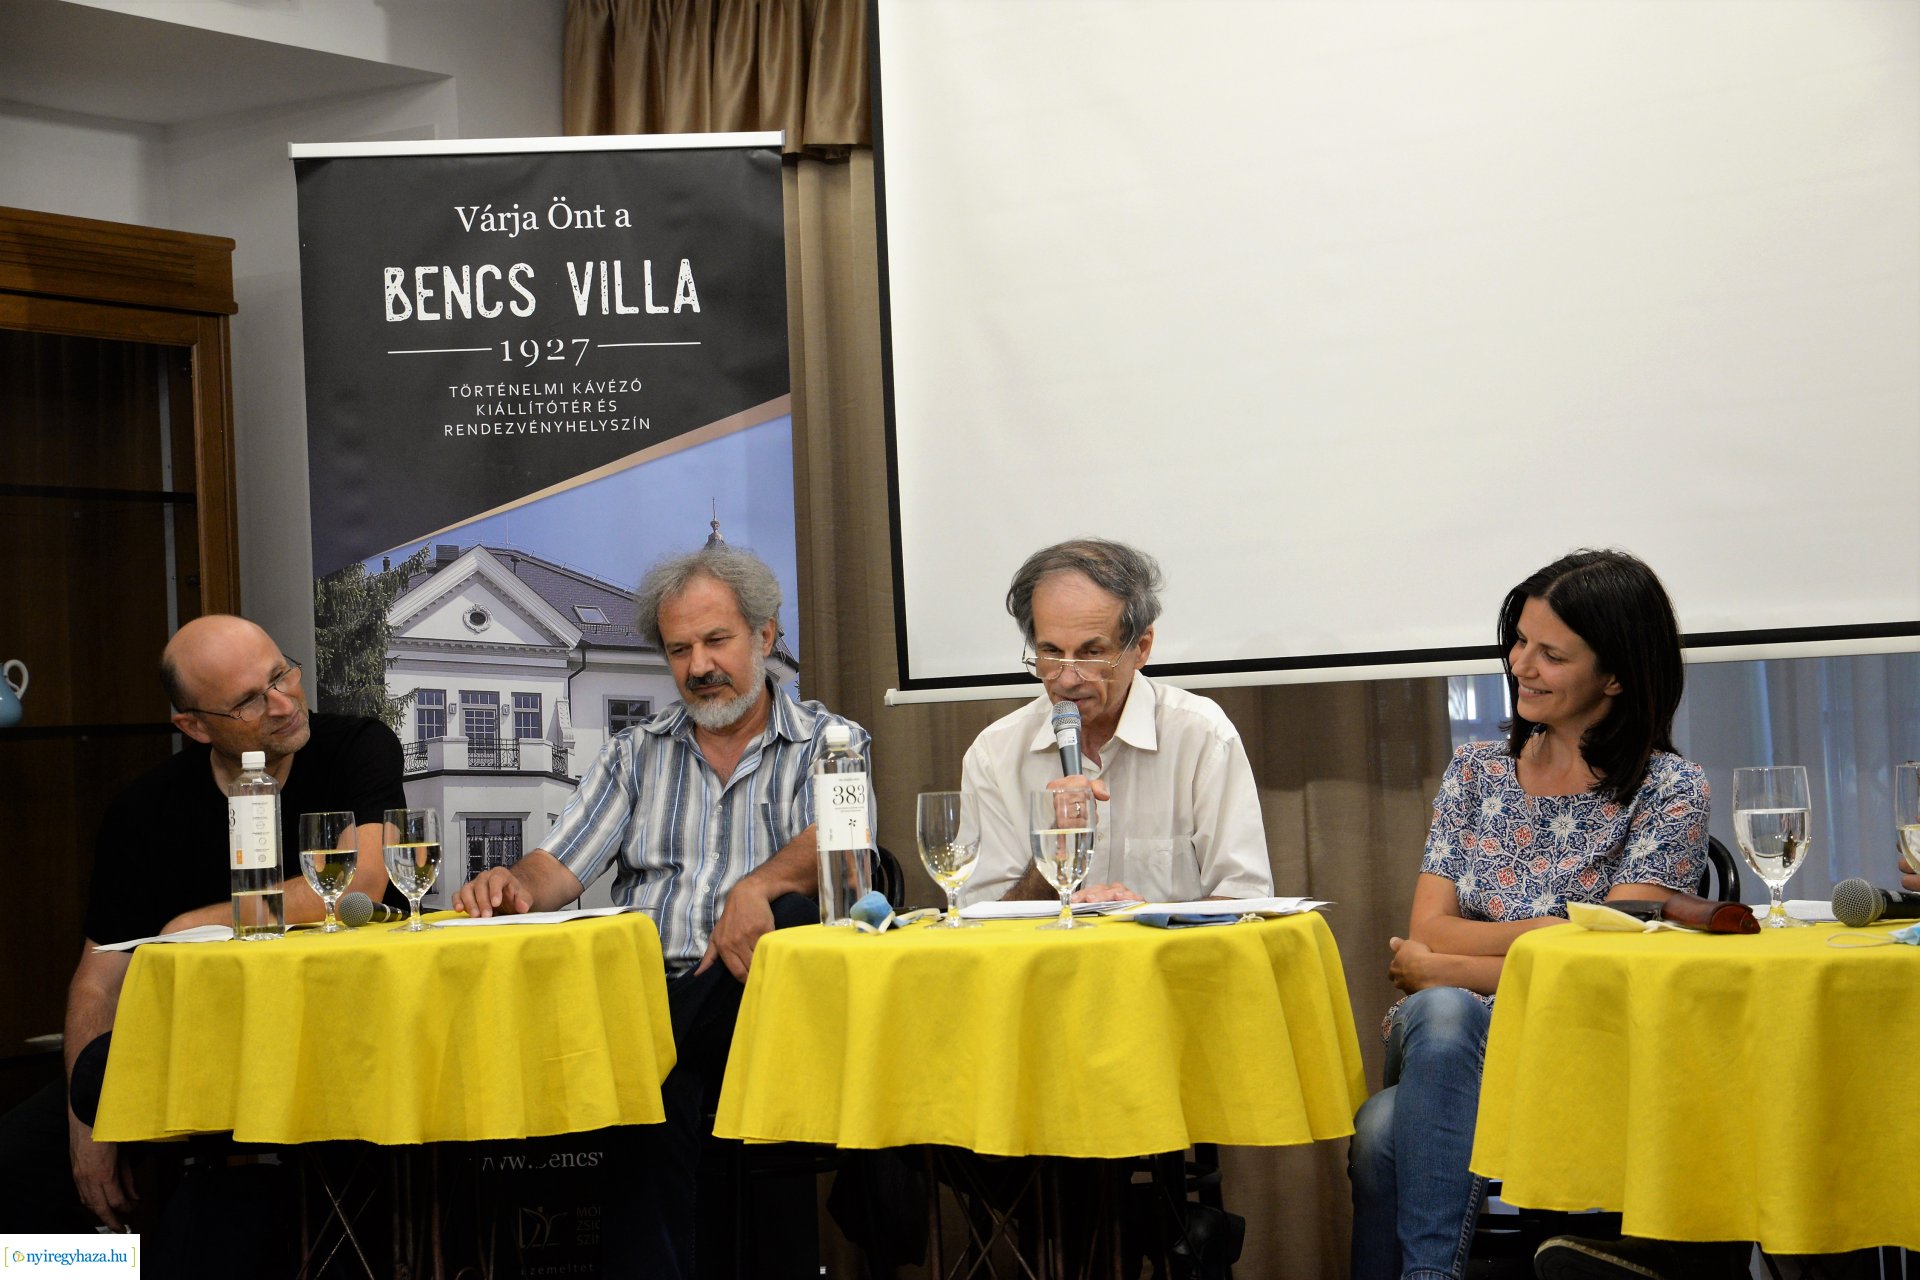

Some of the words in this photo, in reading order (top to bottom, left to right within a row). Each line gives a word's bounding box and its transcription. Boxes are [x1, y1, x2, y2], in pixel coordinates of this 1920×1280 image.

[454, 203, 539, 238] Várja
[547, 196, 607, 230] Önt
[614, 208, 632, 229] a
[383, 262, 537, 323] BENCS
[566, 258, 702, 317] VILLA
[500, 338, 591, 368] 1927
[448, 381, 565, 398] TÖRTÉNELMI
[572, 377, 643, 395] KÁVÉZÓ
[476, 399, 593, 417] KIÁLLÍTÓTÉR
[597, 398, 618, 413] ÉS
[444, 414, 651, 437] RENDEZVÉNYHELYSZÍN
[832, 784, 866, 806] 383
